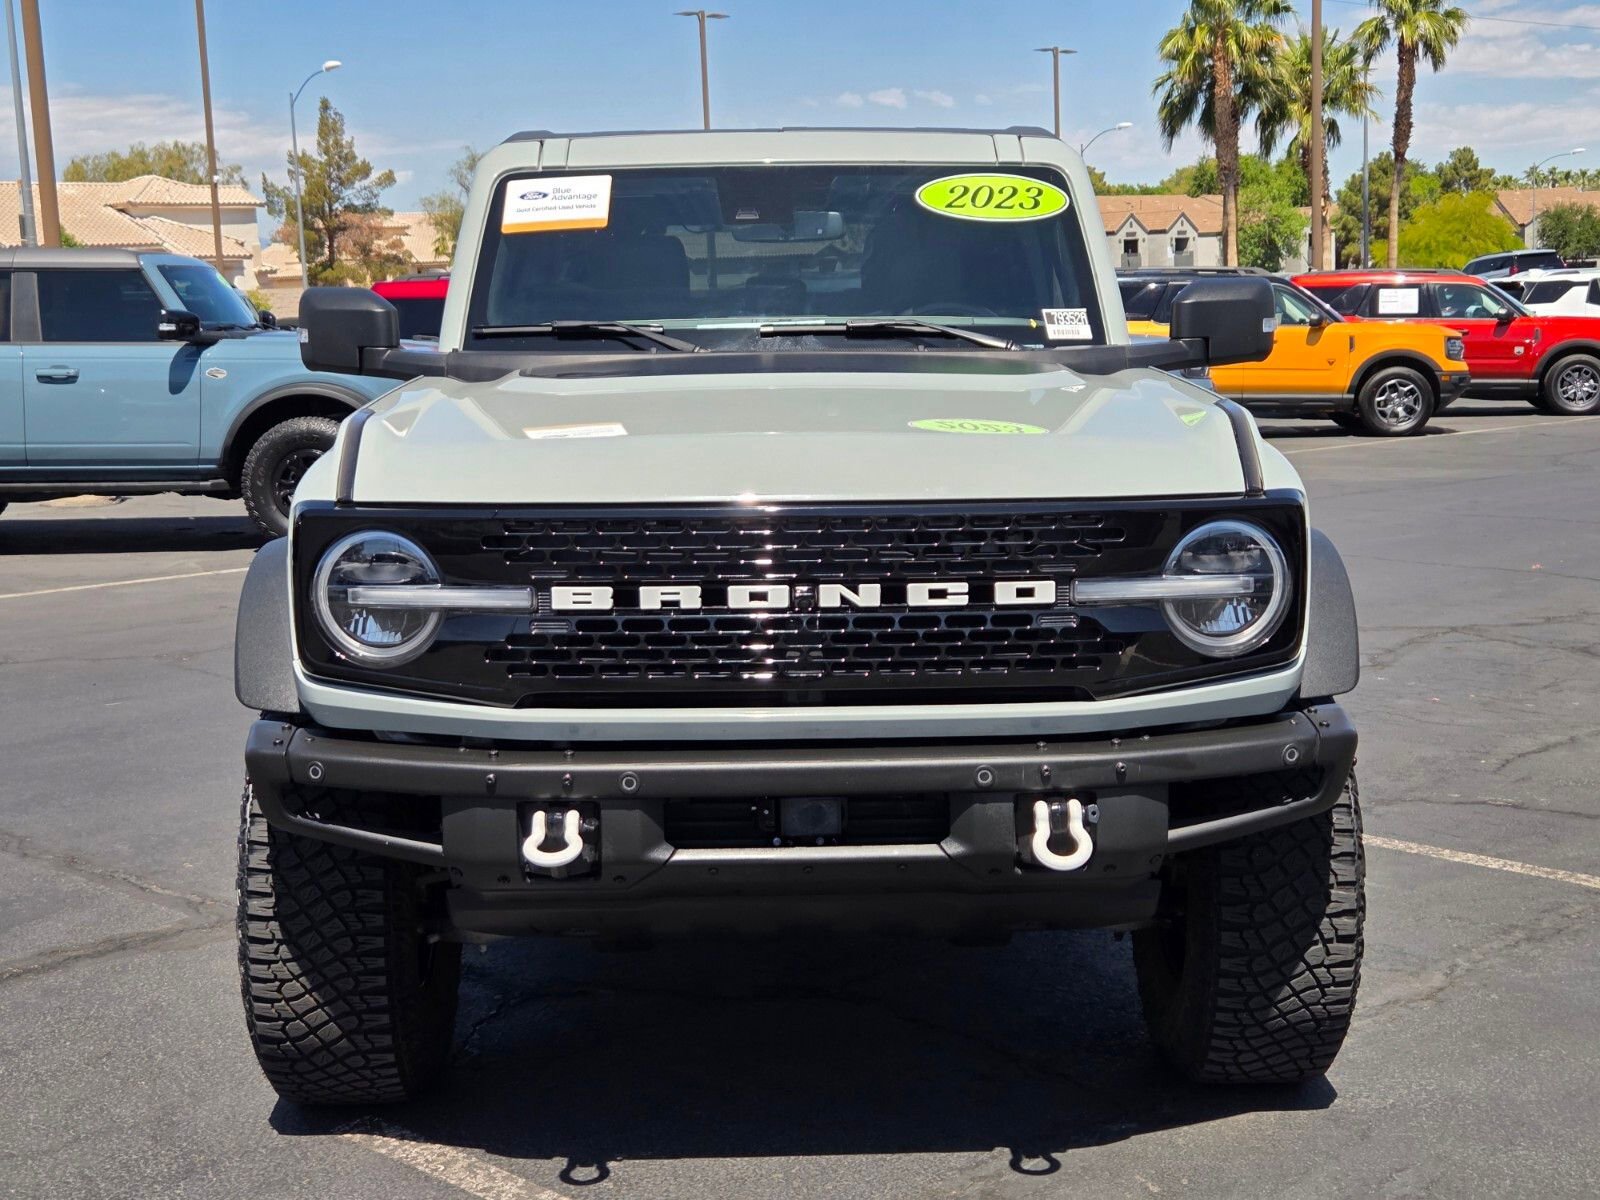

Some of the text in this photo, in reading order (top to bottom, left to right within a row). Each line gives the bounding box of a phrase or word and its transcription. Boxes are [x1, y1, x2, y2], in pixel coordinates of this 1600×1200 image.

[551, 193, 598, 201] Advantage
[944, 184, 1044, 210] 2023
[550, 580, 1056, 611] BRONCO
